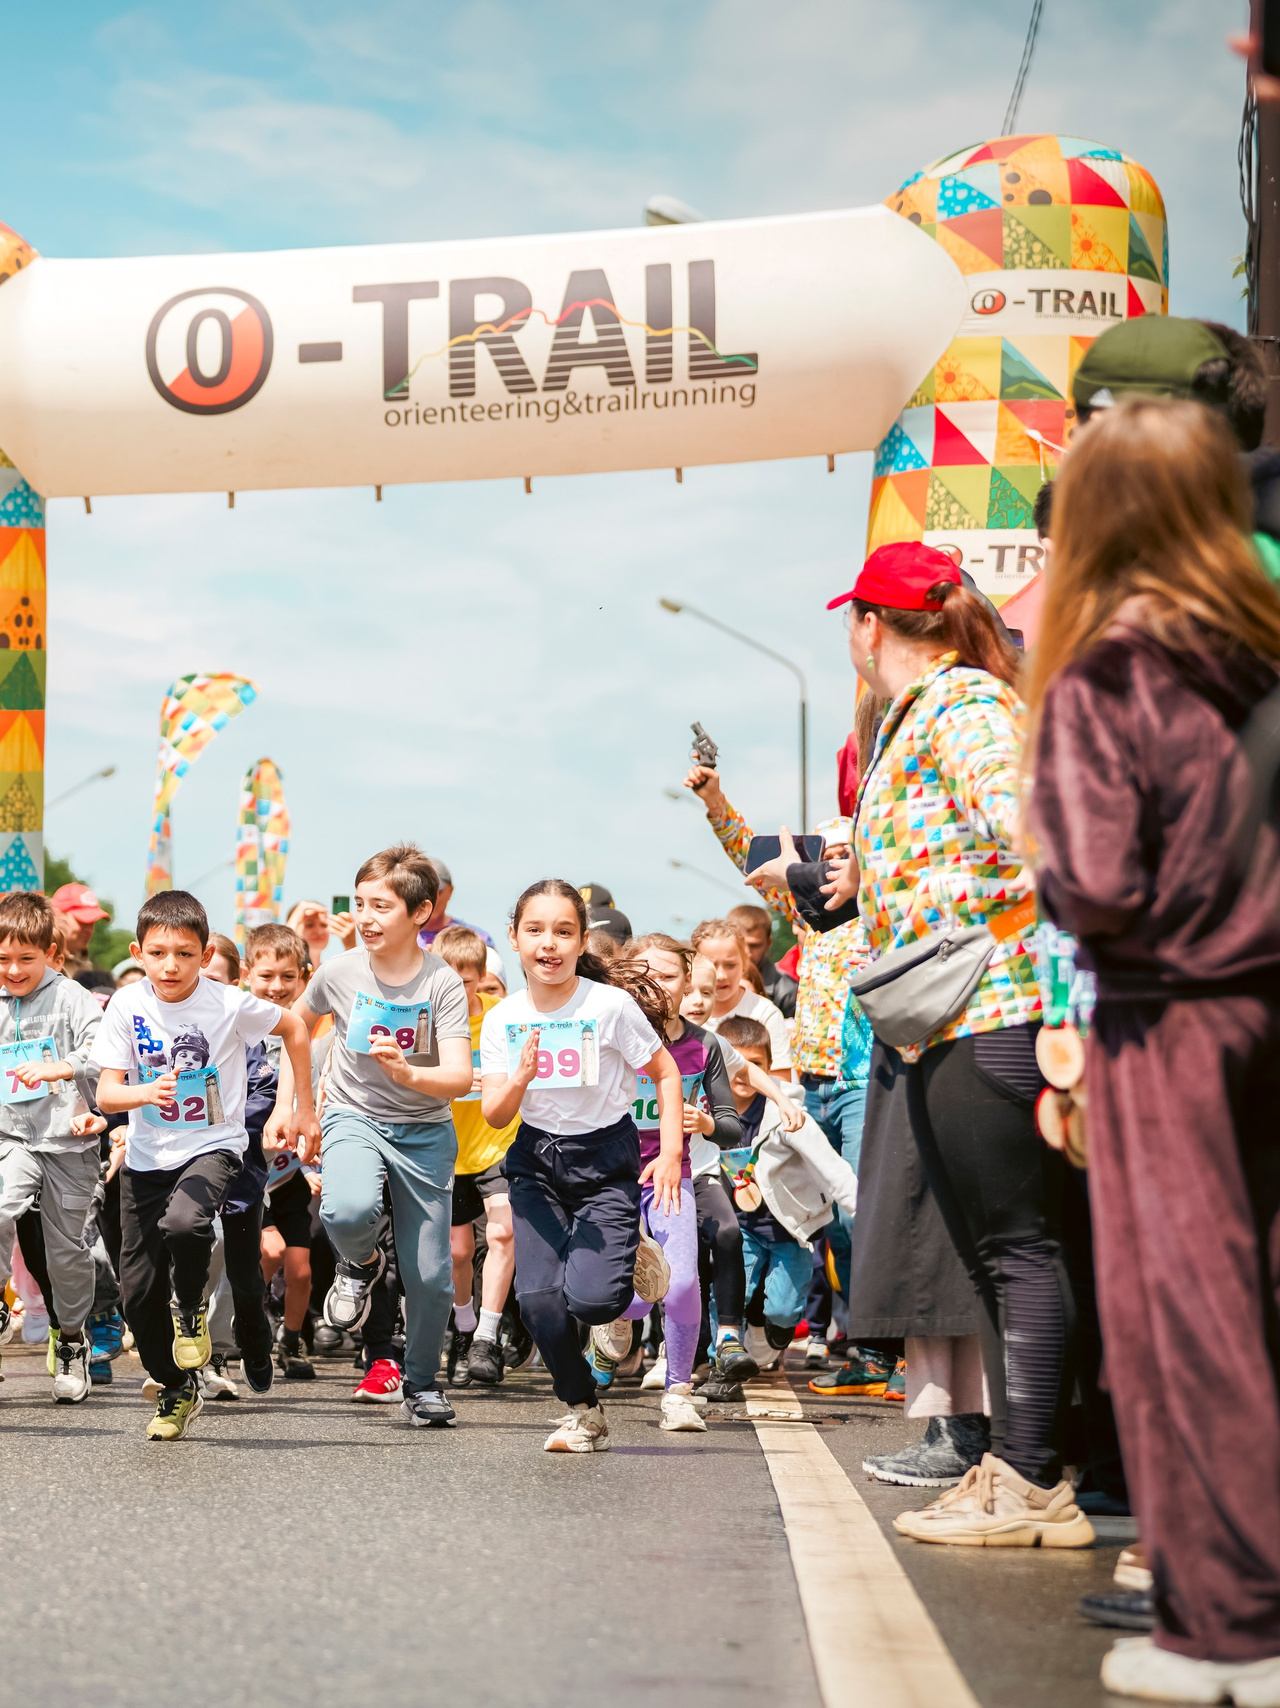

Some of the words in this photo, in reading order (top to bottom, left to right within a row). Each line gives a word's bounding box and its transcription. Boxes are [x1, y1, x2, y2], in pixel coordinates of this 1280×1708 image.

[383, 379, 758, 429] orienteering&trailrunning
[535, 1049, 580, 1079] 99
[159, 1097, 206, 1122] 92
